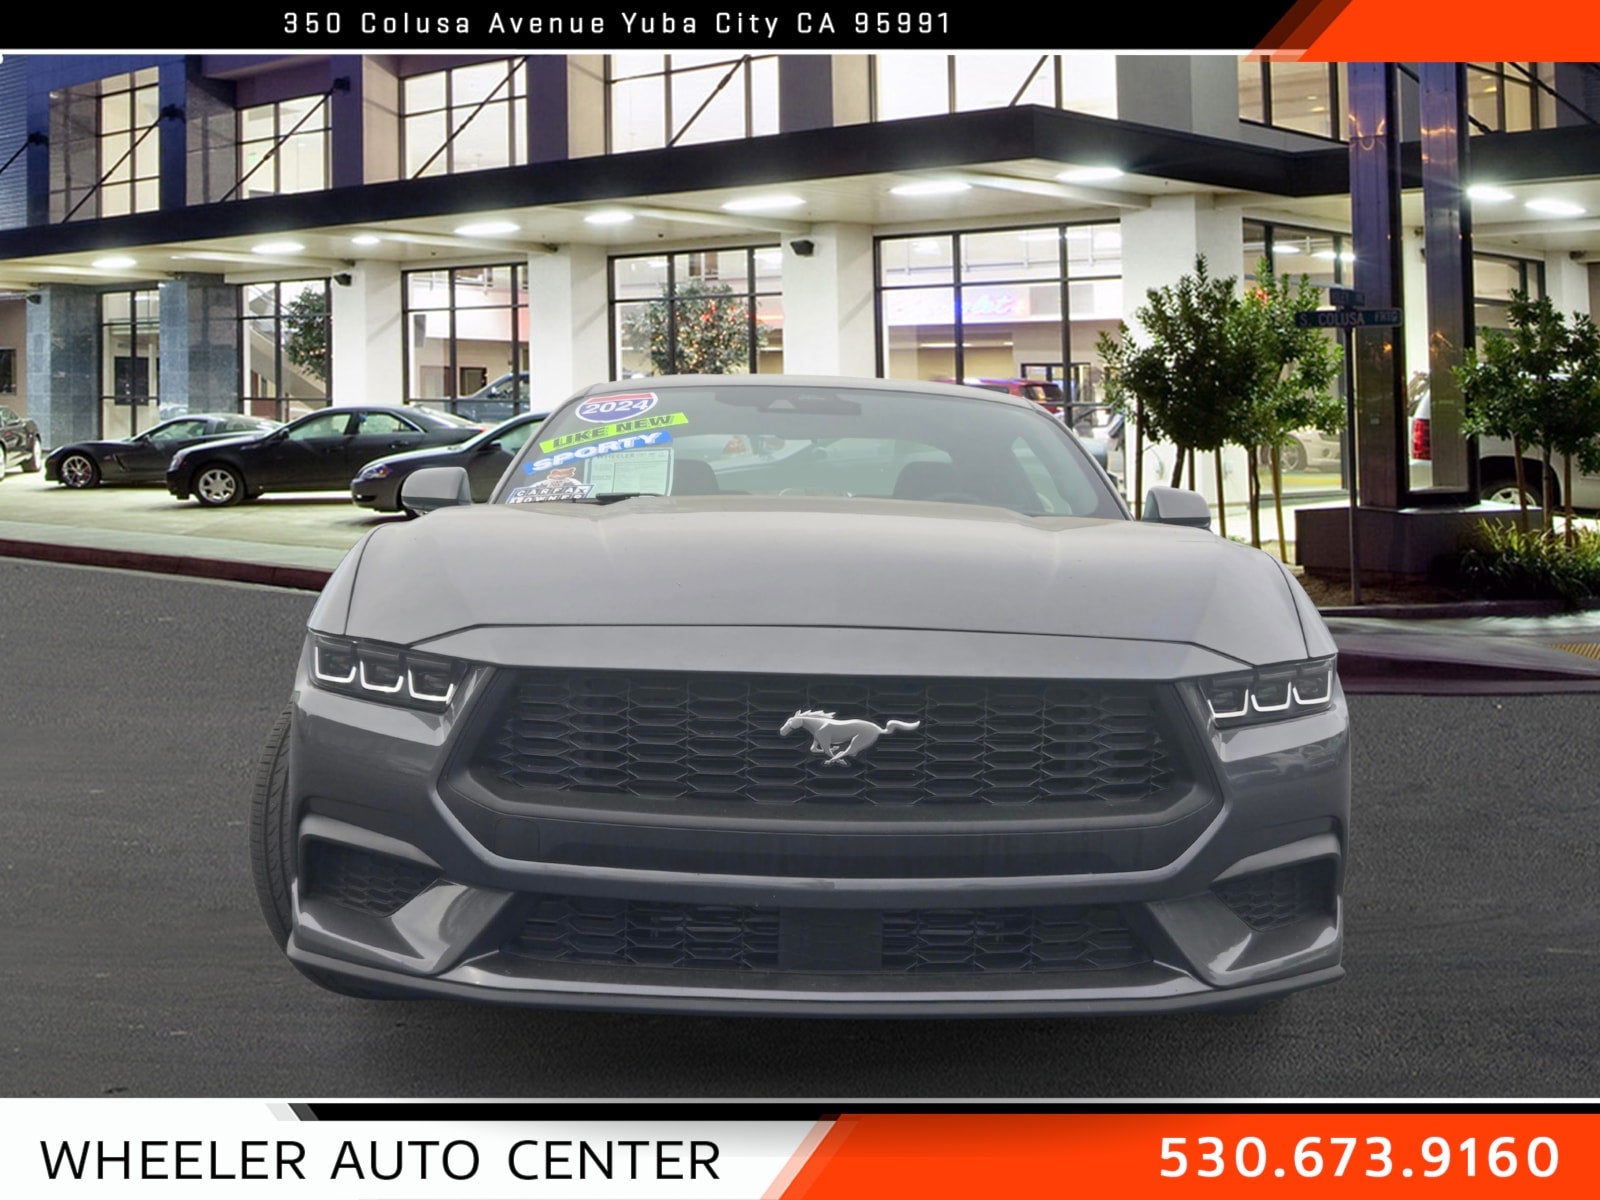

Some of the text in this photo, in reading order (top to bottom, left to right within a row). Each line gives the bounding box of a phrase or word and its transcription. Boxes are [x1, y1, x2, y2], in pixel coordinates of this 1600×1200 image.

[1318, 311, 1365, 326] COLUSA
[583, 400, 650, 415] 2024
[553, 415, 674, 449] LIKE NEW
[532, 432, 663, 471] SPORTY
[516, 486, 588, 497] CARFAX
